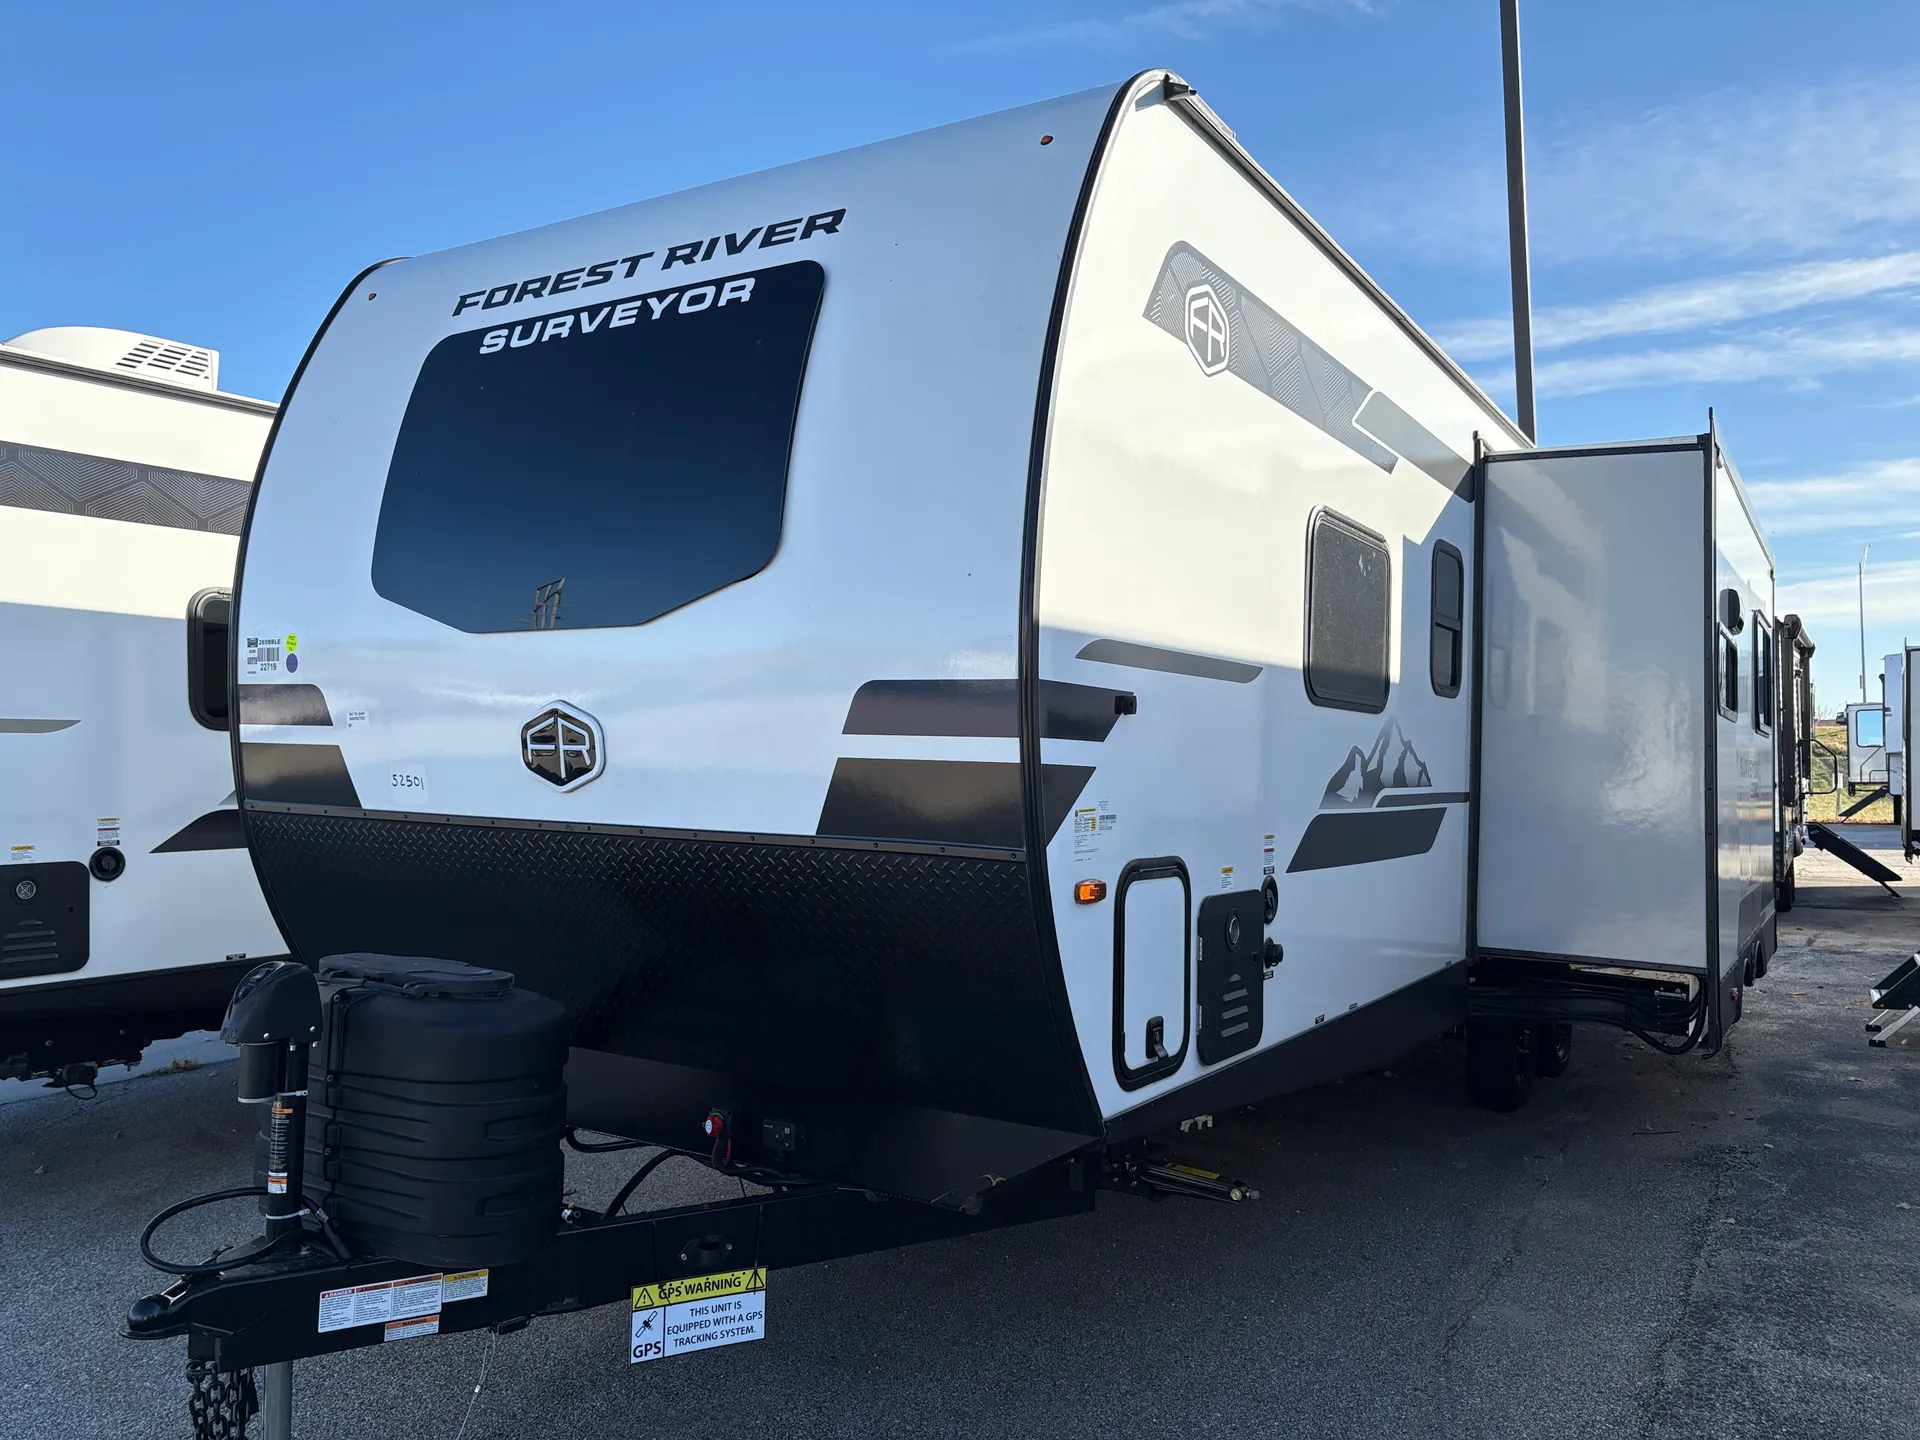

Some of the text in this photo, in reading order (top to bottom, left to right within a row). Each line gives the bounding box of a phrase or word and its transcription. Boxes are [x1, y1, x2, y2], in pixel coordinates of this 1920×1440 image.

[452, 208, 847, 317] FOREST RIVER
[479, 277, 756, 355] SURVEYOR
[260, 663, 277, 671] 22719
[458, 1272, 479, 1280] CAUTION
[329, 1289, 352, 1297] DANGER
[658, 1277, 741, 1300] GPS WARNING
[690, 1301, 742, 1317] THIS UNIT IS
[402, 1318, 427, 1327] WARNING
[667, 1310, 763, 1335] EQUIPPED WITH A GPS
[674, 1325, 756, 1347] TRACKING SYSTEM.
[633, 1341, 661, 1358] GPS
